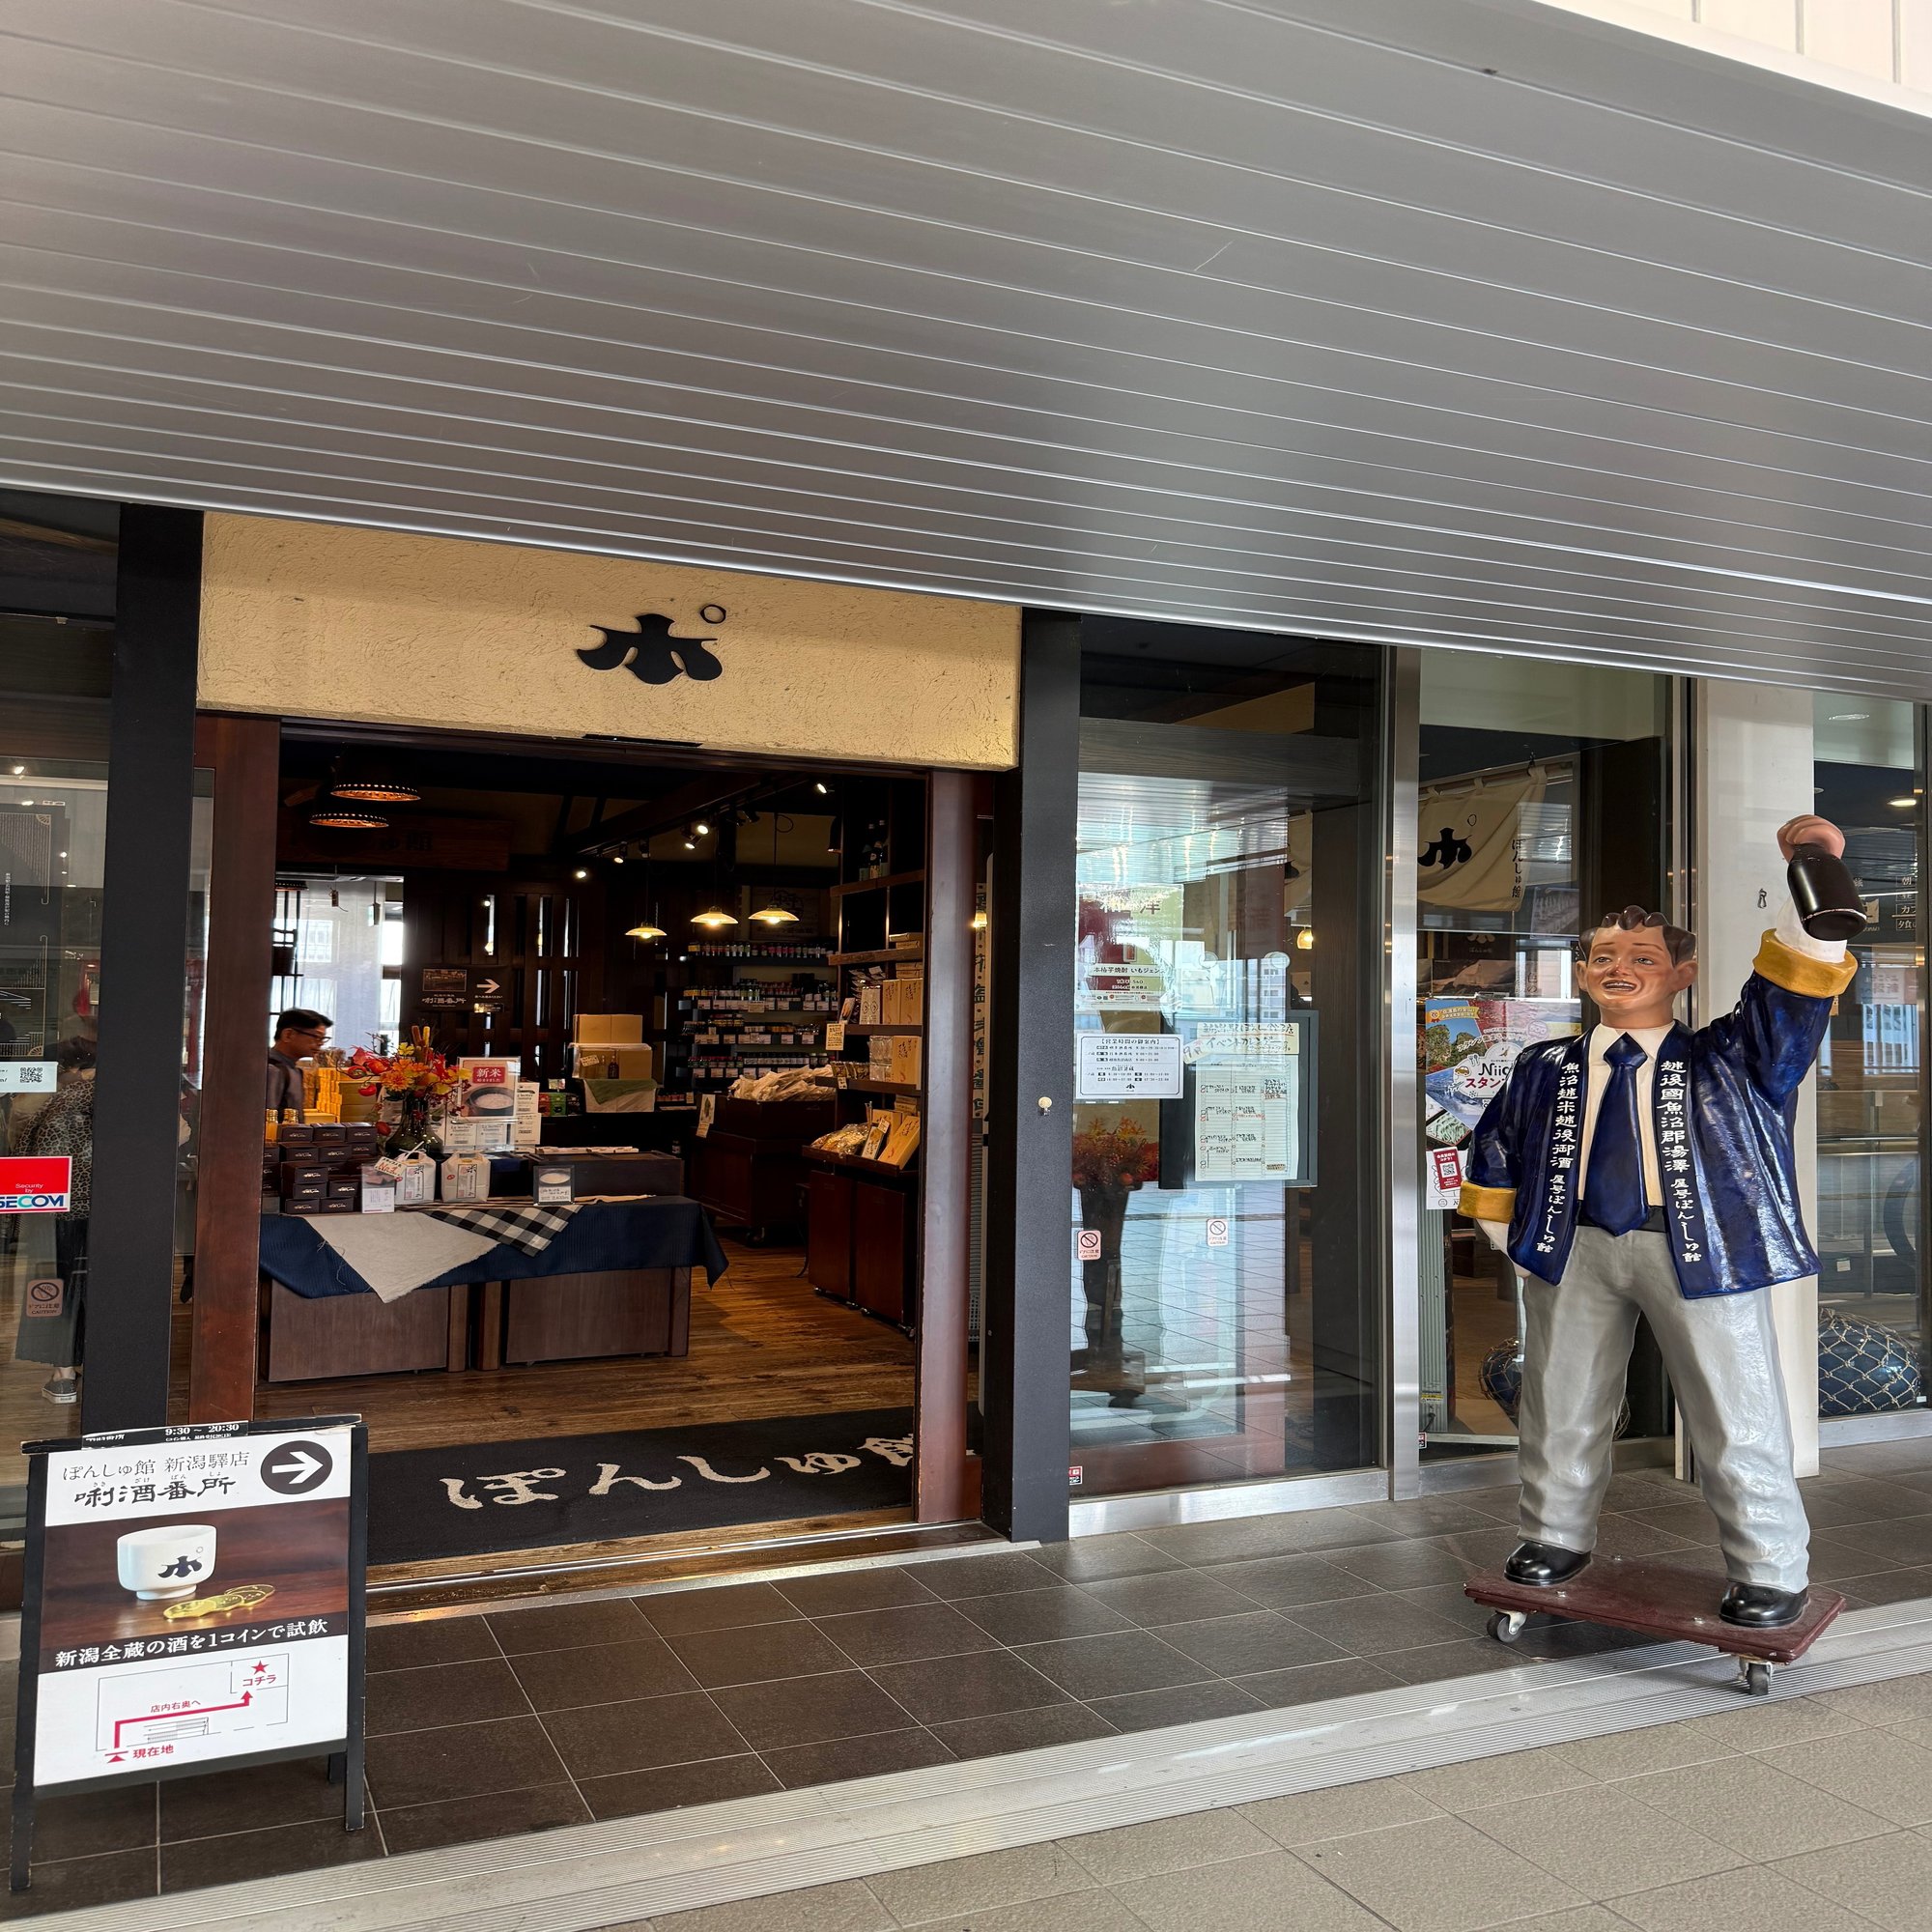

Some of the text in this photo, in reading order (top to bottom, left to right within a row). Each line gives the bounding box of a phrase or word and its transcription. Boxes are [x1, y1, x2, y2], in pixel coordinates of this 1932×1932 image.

[477, 1068, 501, 1077] 新米
[165, 1427, 190, 1435] 9:30
[208, 1423, 240, 1433] 20:30
[63, 1451, 250, 1480] ぽんしゅ館 新潟驛店
[73, 1476, 237, 1507] 唎酒番所
[54, 1618, 328, 1667] 新潟全蔵の酒を1コインで試飲
[242, 1673, 277, 1687] コチラ
[150, 1699, 201, 1714] 店内右奥へ
[131, 1744, 175, 1759] 現在地
